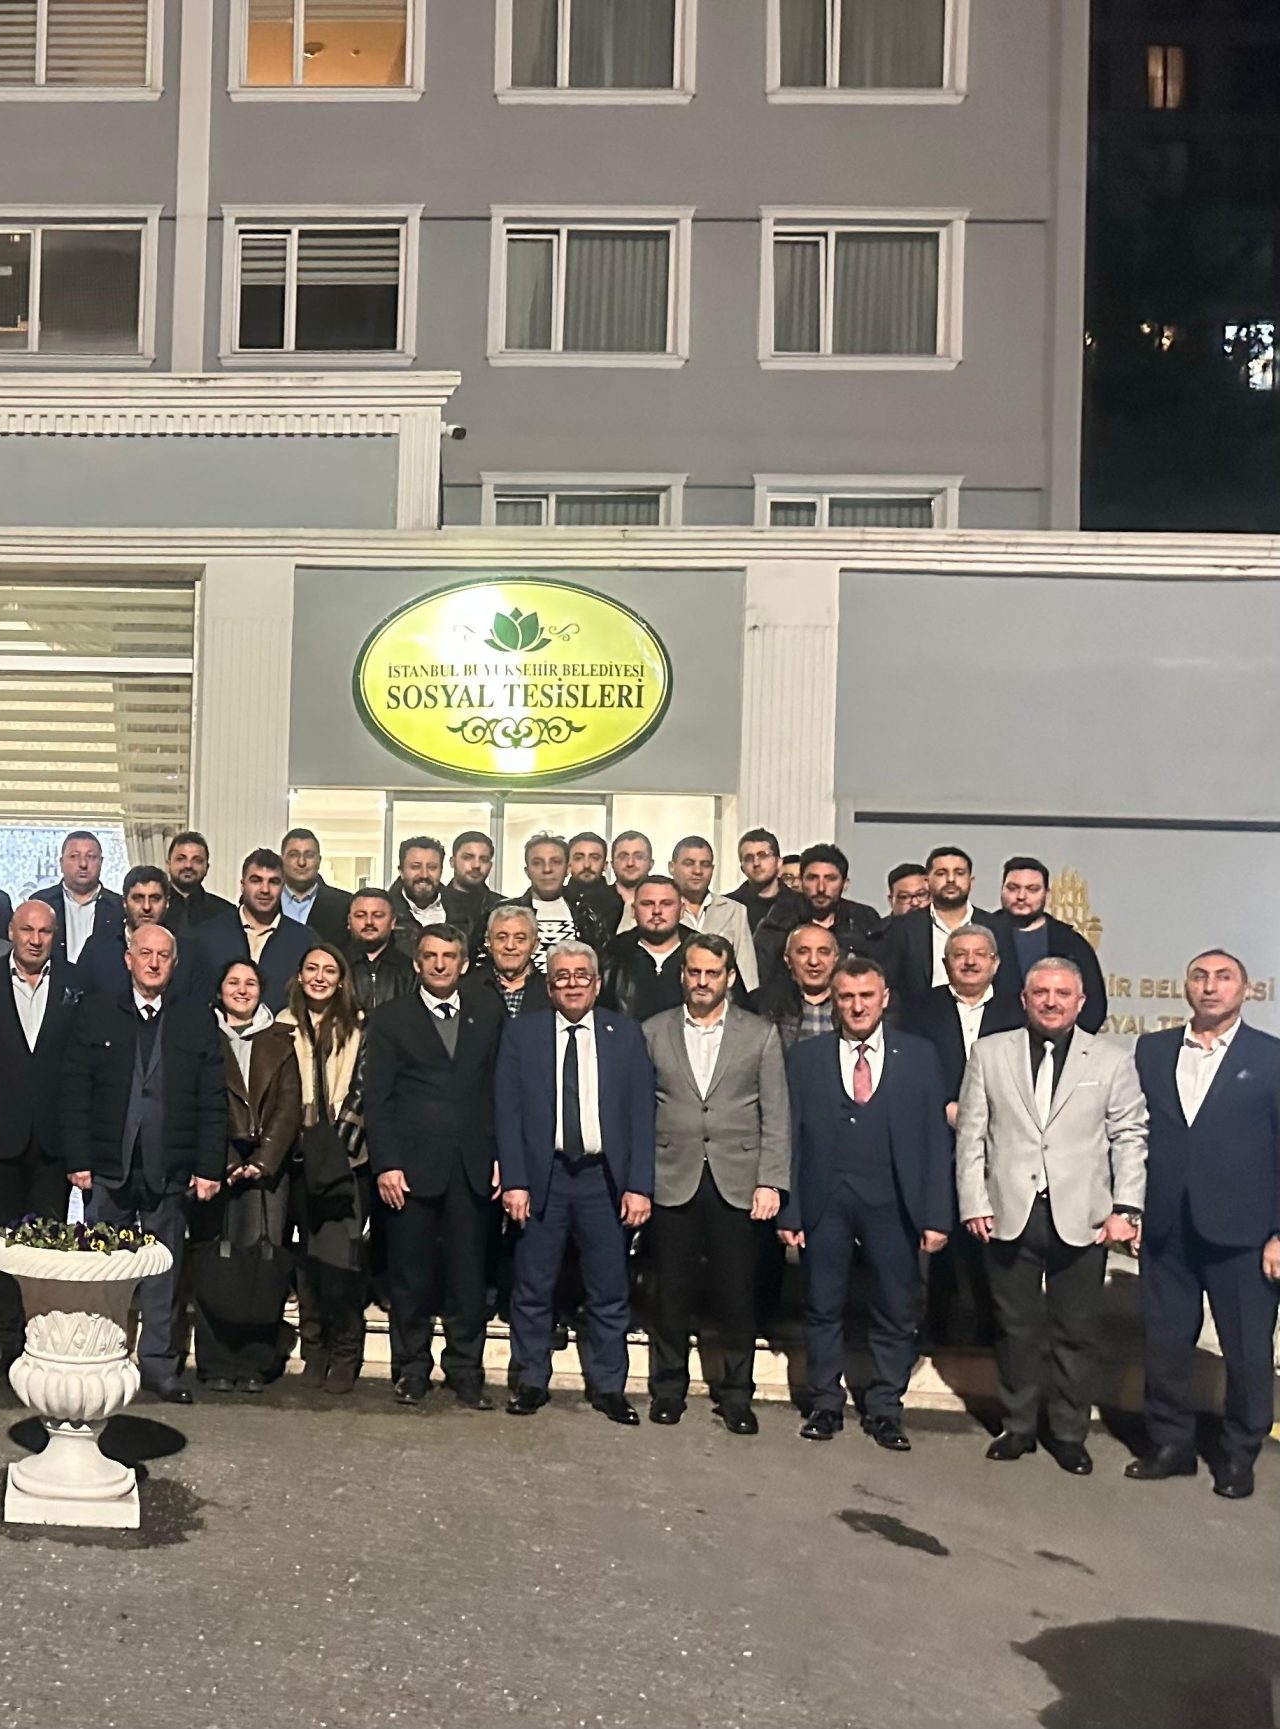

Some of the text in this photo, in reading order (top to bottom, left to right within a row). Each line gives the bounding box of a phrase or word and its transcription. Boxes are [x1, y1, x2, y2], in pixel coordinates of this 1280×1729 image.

[387, 661, 459, 678] İSTANBUL
[562, 660, 645, 678] BELEDİYESİ
[386, 677, 645, 710] SOSYAL TESİSLERİ
